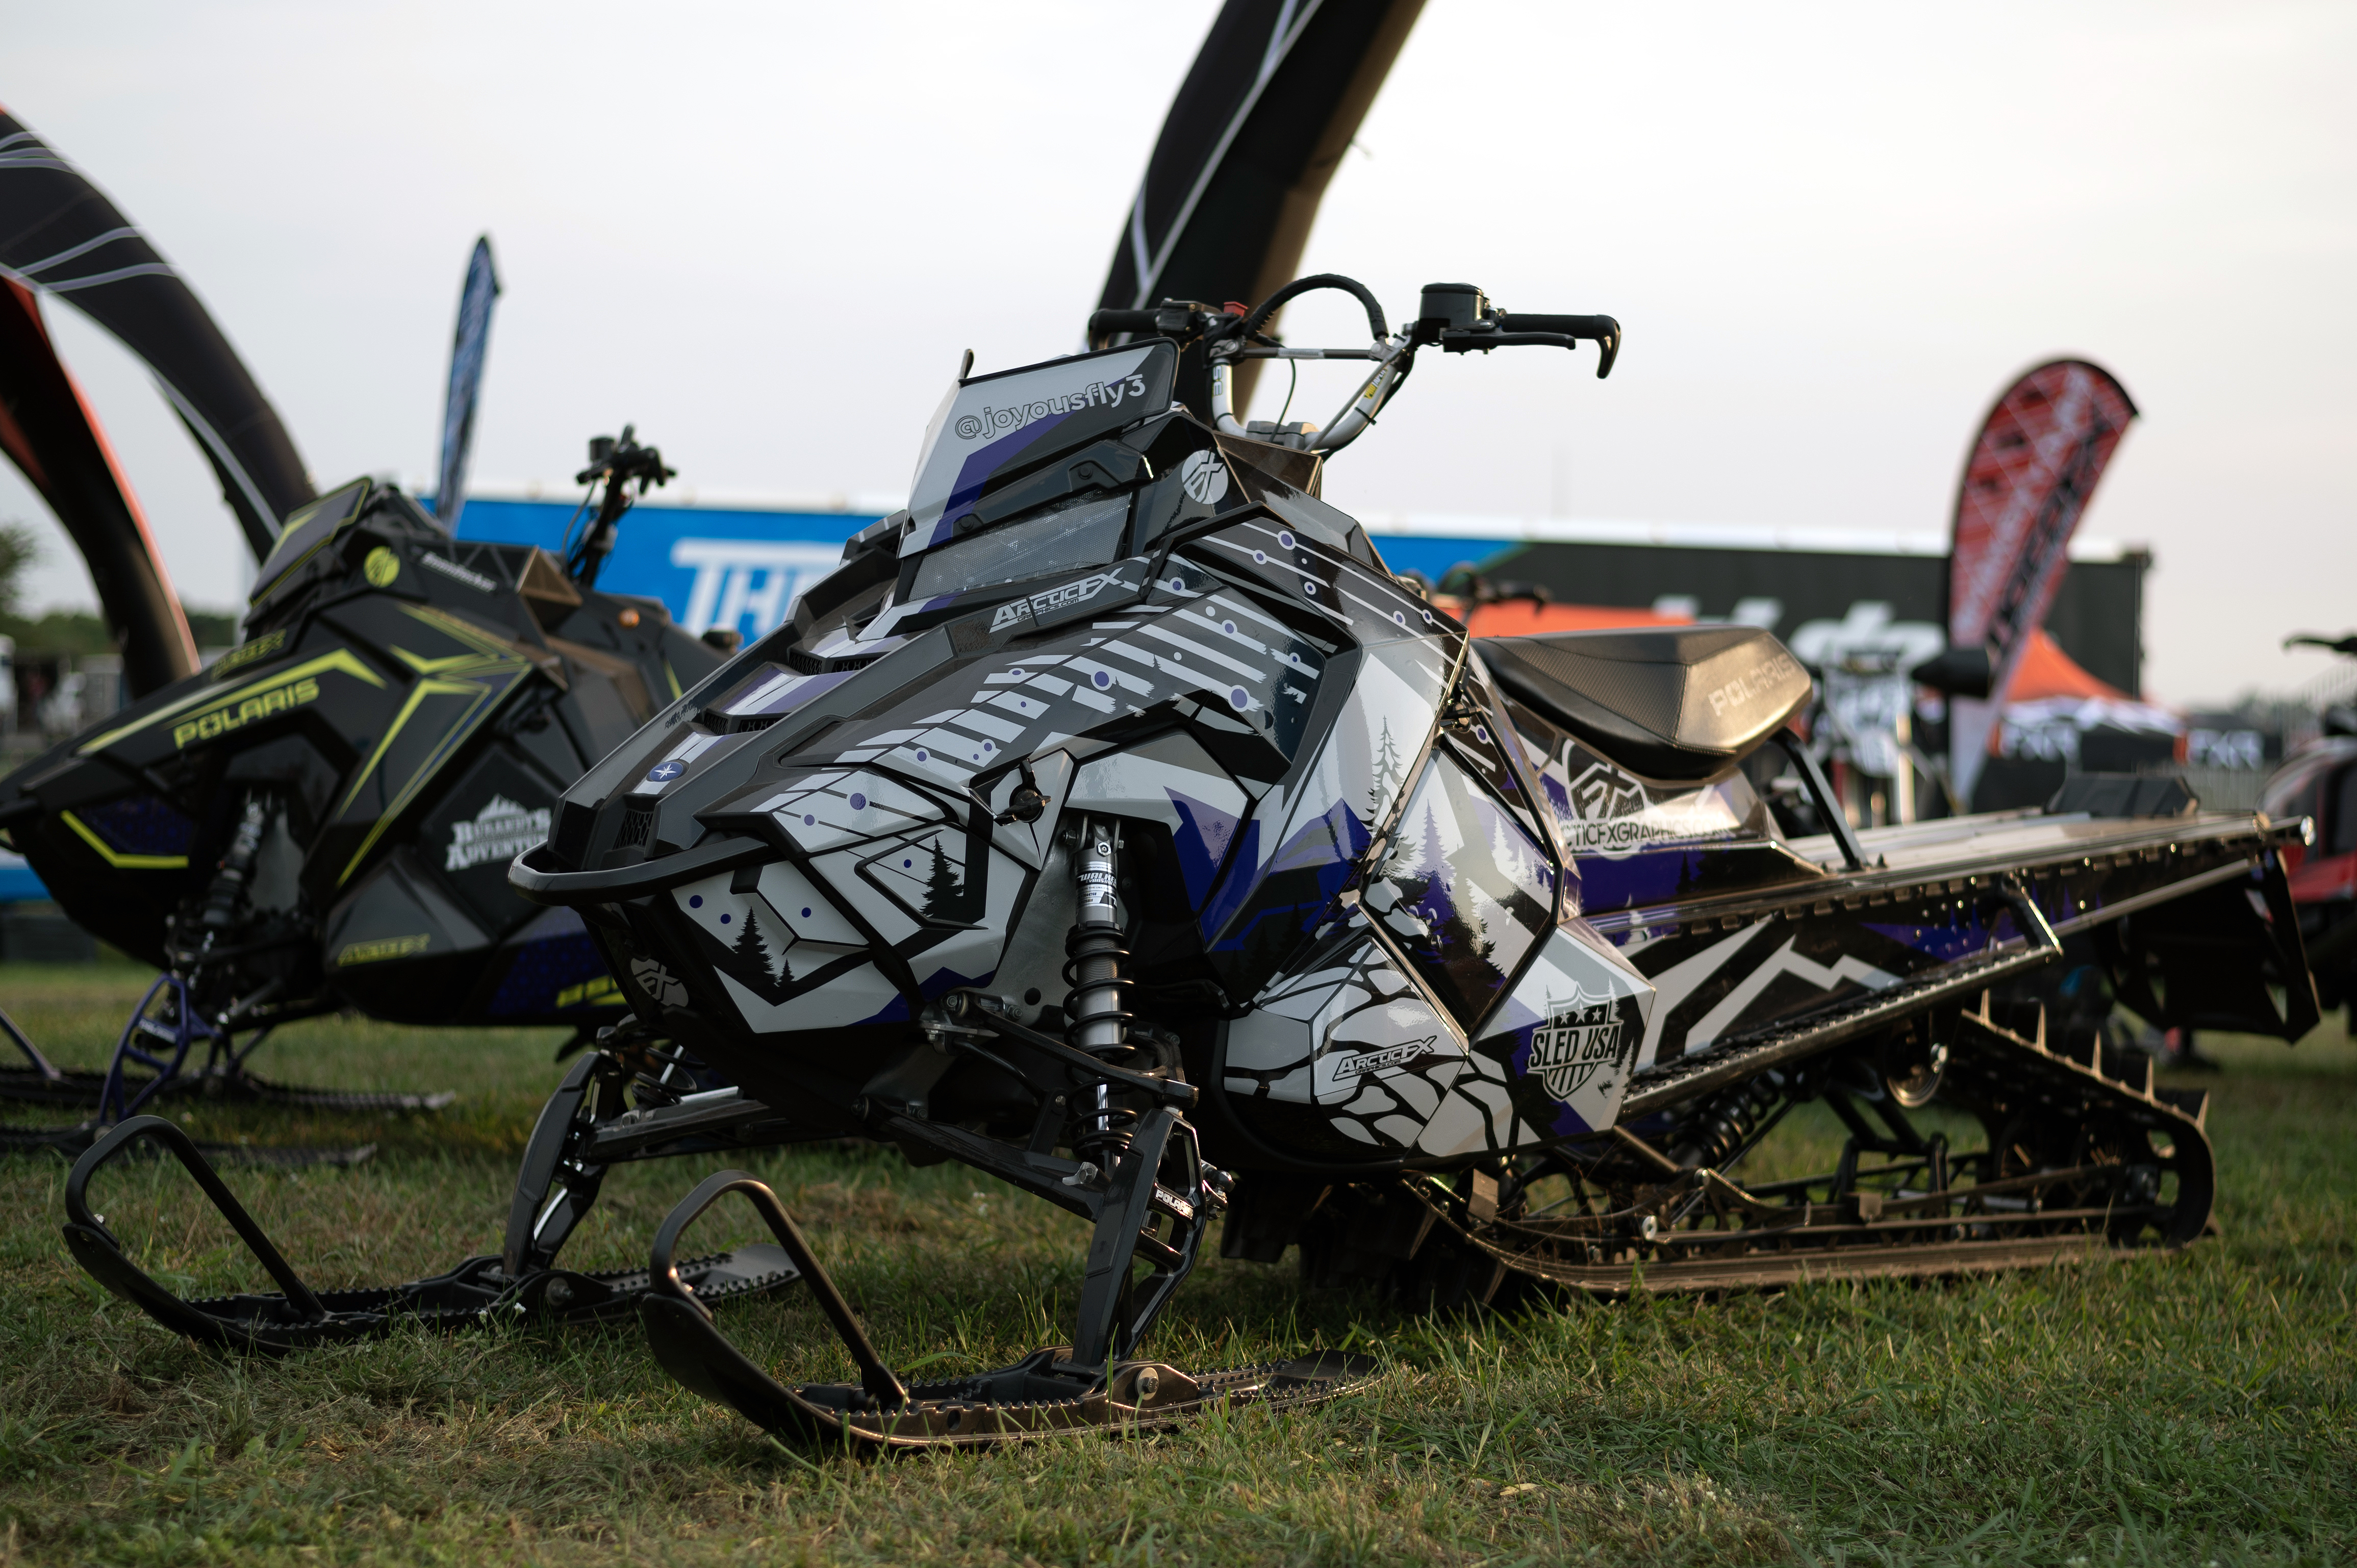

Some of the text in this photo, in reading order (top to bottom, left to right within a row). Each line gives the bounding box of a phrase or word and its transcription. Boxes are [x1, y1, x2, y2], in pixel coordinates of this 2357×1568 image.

[955, 374, 1146, 439] @joyousfly3
[173, 677, 320, 750] POLARIS
[1709, 653, 1796, 717] POLARIS
[1530, 1024, 1620, 1068] SLED USA
